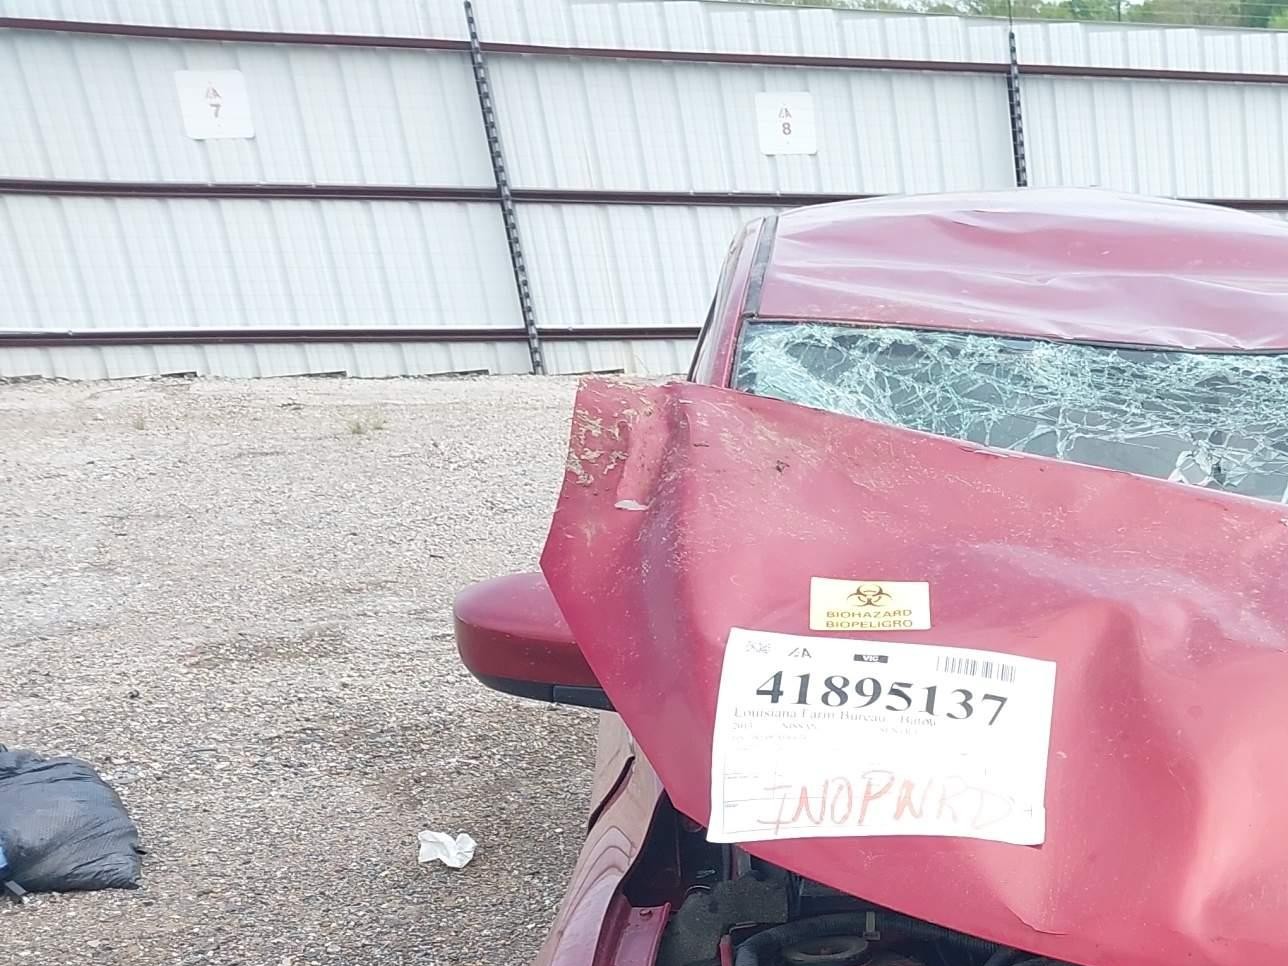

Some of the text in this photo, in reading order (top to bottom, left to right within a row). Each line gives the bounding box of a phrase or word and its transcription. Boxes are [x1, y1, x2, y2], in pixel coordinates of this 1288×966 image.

[209, 103, 221, 118] 7
[782, 122, 792, 135] 8
[826, 609, 913, 618] BIOHAZARD
[825, 619, 913, 628] BIOPELIGRO
[756, 670, 1008, 726] 41895137
